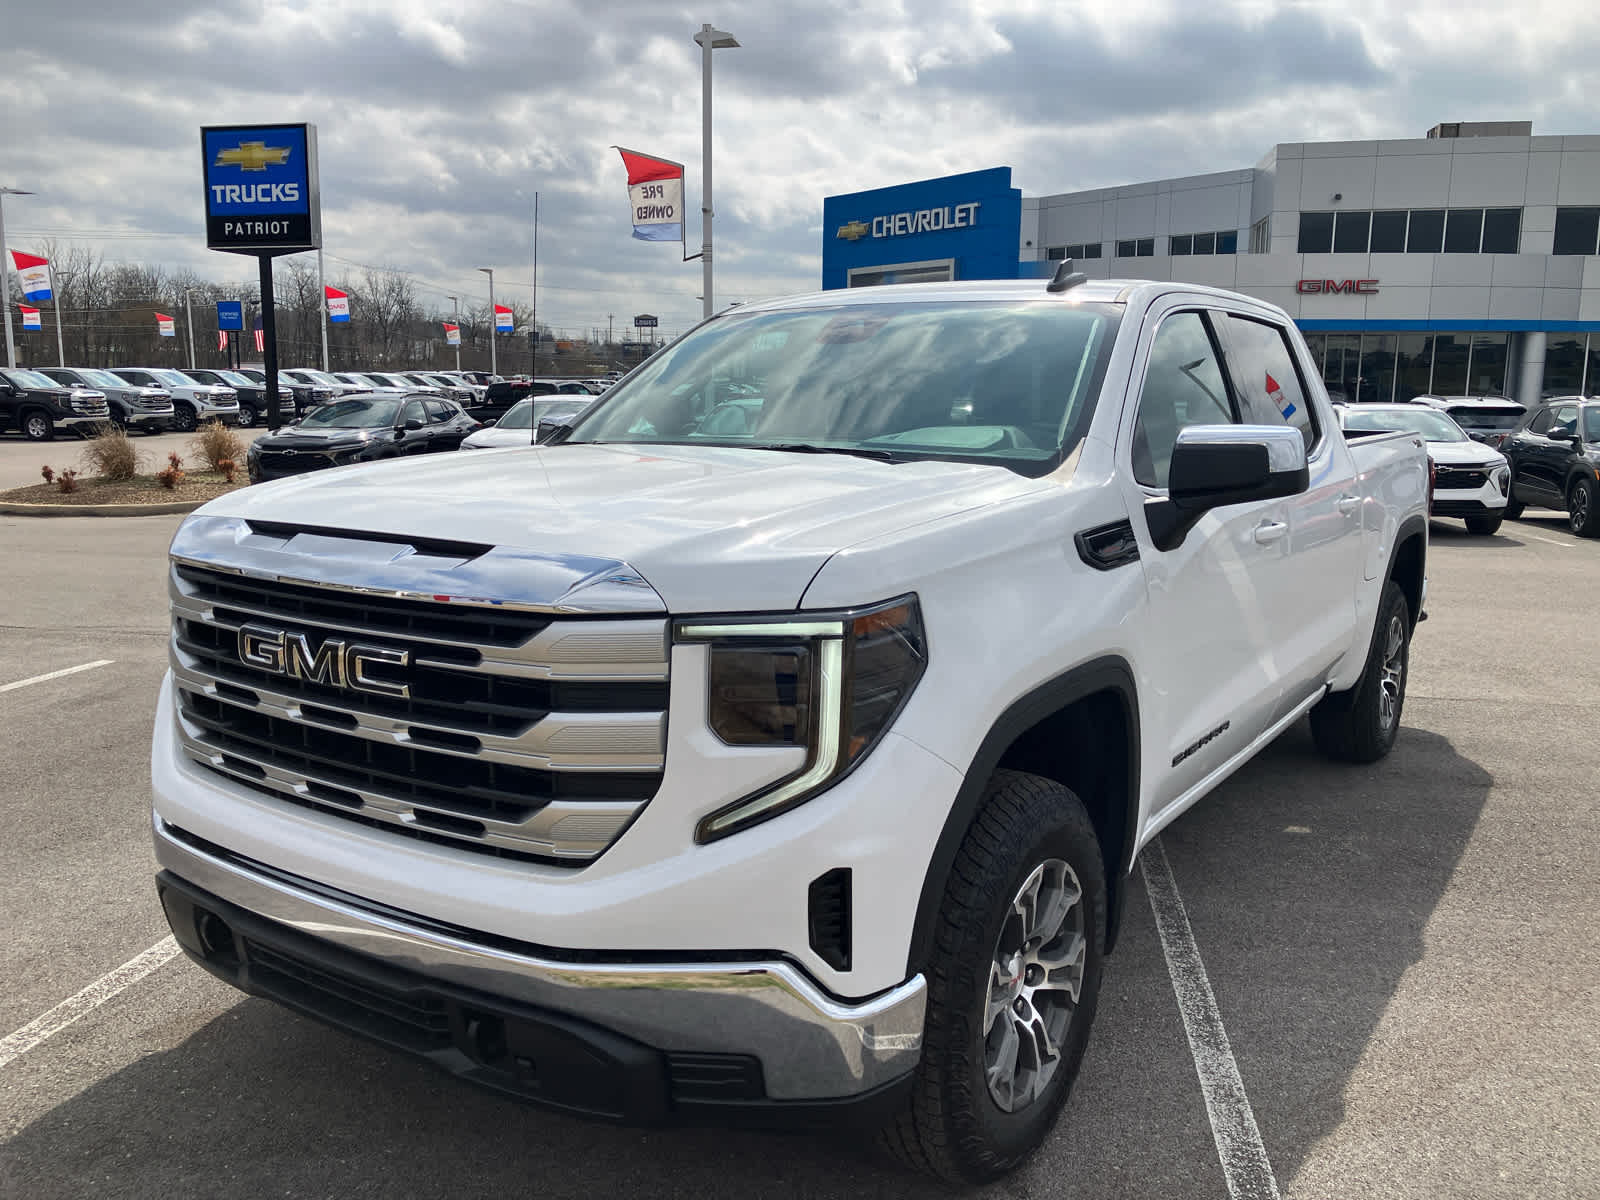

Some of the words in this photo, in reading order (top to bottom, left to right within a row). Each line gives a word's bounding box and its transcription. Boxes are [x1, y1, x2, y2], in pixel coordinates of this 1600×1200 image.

[211, 183, 299, 203] TRUCKS
[224, 221, 289, 235] PATRIOT
[872, 202, 981, 238] CHEVROLET
[1296, 279, 1379, 295] GMC
[238, 622, 410, 699] GMC
